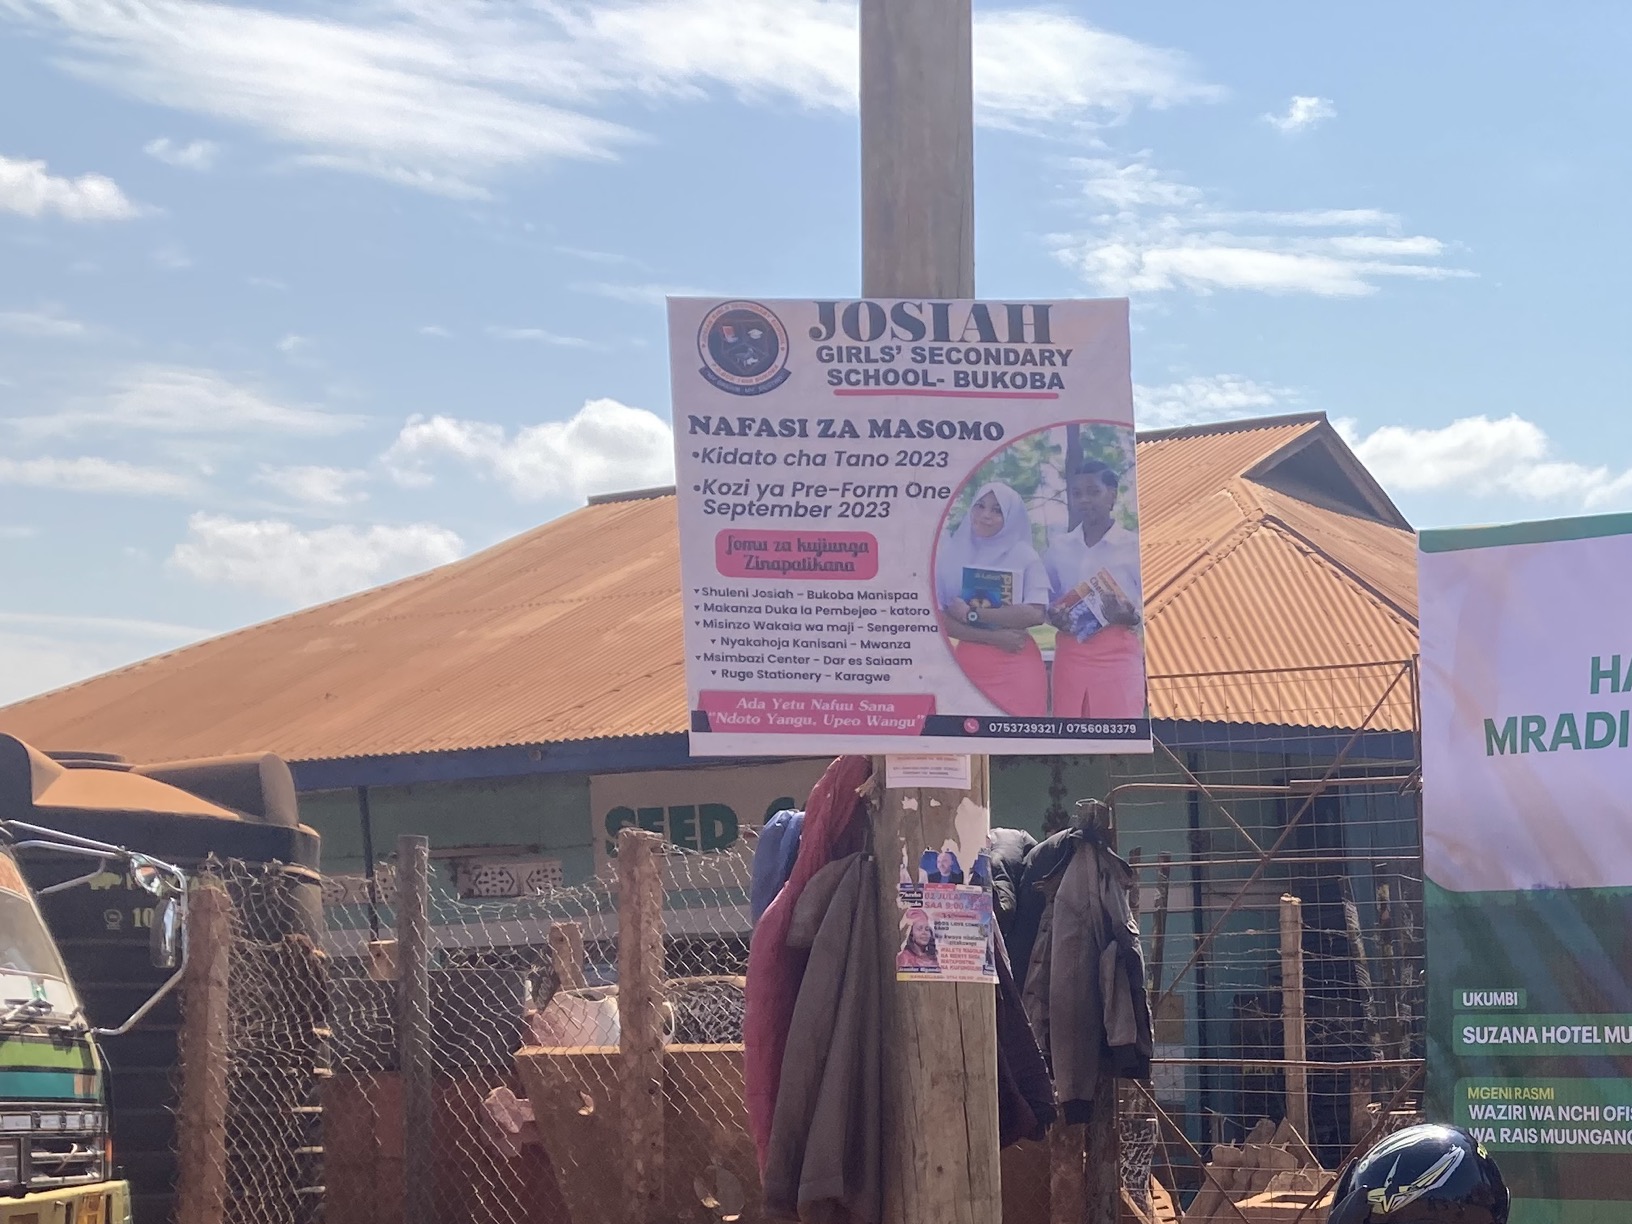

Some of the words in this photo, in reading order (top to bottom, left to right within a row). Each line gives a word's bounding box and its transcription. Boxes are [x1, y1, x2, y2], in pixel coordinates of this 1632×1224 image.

[808, 301, 1056, 344] JOSIAH
[911, 346, 1073, 367] SECONDARY
[954, 370, 1065, 390] BUKOBA
[688, 415, 809, 438] NAFASI
[816, 419, 865, 439] ZA
[868, 419, 1004, 441] MASOMO
[701, 447, 777, 466] Kidato
[783, 449, 827, 468] cha
[834, 451, 889, 468] Tano
[895, 451, 949, 468] 2023
[702, 478, 750, 497] Kozi
[756, 485, 785, 502] ya
[791, 482, 899, 499] Pre-Form
[905, 482, 951, 500] One
[703, 498, 832, 521] September
[838, 501, 890, 519] 2023
[773, 540, 792, 552] za
[744, 554, 855, 575] Zinapatikana
[702, 587, 749, 598] Shuleni
[752, 588, 793, 599] Josiah
[807, 590, 853, 600] Bukoba
[857, 590, 918, 602] Manispaa
[704, 603, 762, 614] Makanza
[765, 604, 797, 615] Duka
[801, 604, 812, 615] la
[815, 605, 877, 619] Pembejeo
[890, 606, 930, 616] katoro
[703, 618, 750, 630] Misinzo
[753, 621, 802, 632] Wakala
[805, 623, 824, 632] wa
[826, 621, 855, 635] maji
[867, 622, 938, 636] Sengerema
[720, 636, 790, 650] Nyakahoja
[792, 638, 847, 649] Kanisani
[860, 639, 911, 649] Mwanza
[703, 653, 764, 664] Msimbazi
[823, 655, 846, 665] Dar
[848, 657, 863, 665] es
[866, 655, 913, 666] Salaam
[757, 669, 821, 682] Stationery
[835, 671, 891, 684] Karagwe
[736, 697, 765, 710] Ada
[772, 698, 804, 711] Yetu
[810, 699, 853, 712] Nafuu
[858, 700, 895, 713] Sana
[823, 714, 861, 728] Upeo
[989, 722, 1056, 734] 0753739321
[1066, 723, 1137, 734] 0756083379
[1484, 709, 1629, 757] MRADI
[605, 803, 739, 858] SEED
[1462, 991, 1518, 1007] UKUMBI
[1462, 1026, 1538, 1044] SUZANA
[1542, 1026, 1601, 1044] HOTEL
[1467, 1086, 1512, 1100] MGENI
[1514, 1087, 1554, 1100] RASMI
[1468, 1104, 1527, 1121] WAZIRI
[1529, 1105, 1556, 1121] WA
[1558, 1105, 1600, 1122] NCHI
[1468, 1127, 1496, 1143] WA
[1500, 1128, 1538, 1144] RAIS
